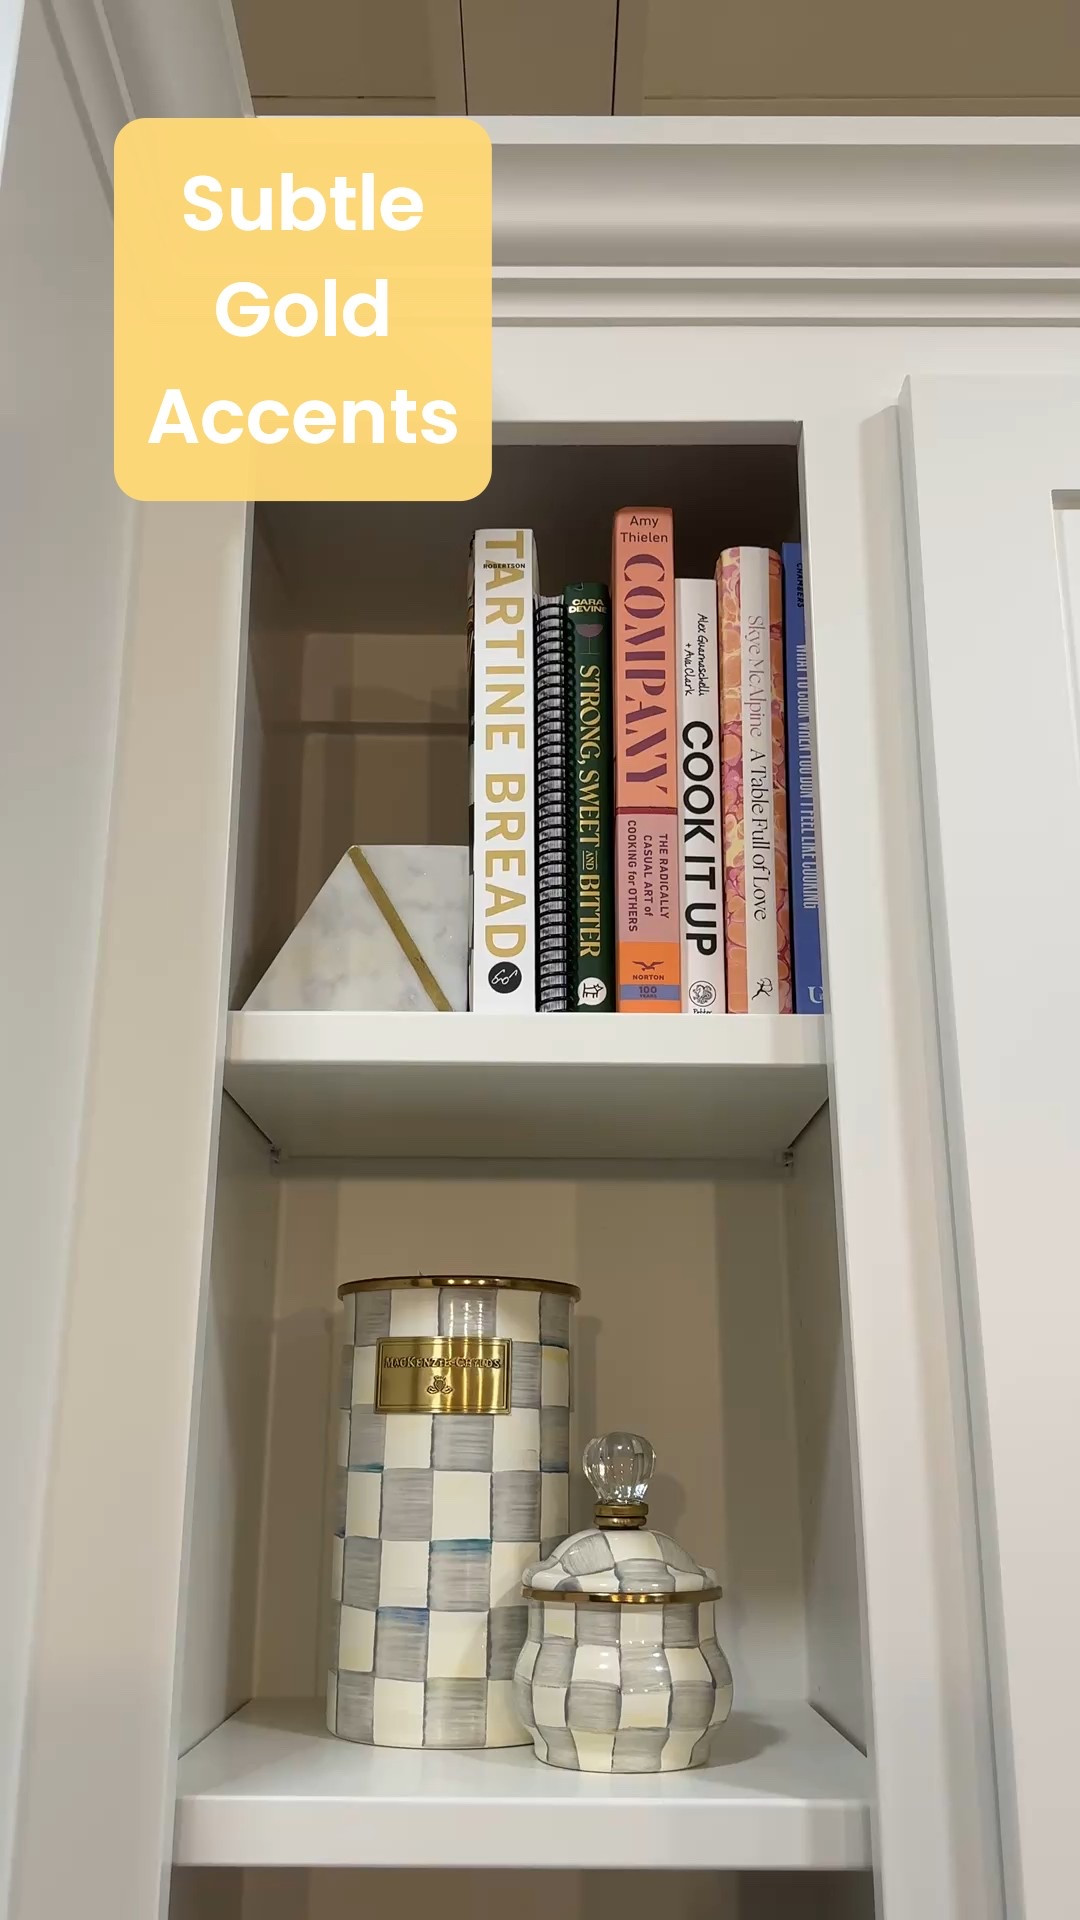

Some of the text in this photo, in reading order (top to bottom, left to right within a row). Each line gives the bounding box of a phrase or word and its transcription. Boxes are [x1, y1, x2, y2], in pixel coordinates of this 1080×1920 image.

[620, 531, 669, 544] Thielen
[629, 514, 659, 528] Amy
[568, 606, 608, 614] DEVINE
[571, 598, 605, 606] CARA
[697, 612, 709, 634] Alex
[623, 553, 668, 795] COMPANY
[684, 648, 695, 668] Ava
[684, 667, 696, 697] Clark
[744, 615, 767, 738] Skye McAlpine
[485, 530, 527, 958] TARTINE BREAD
[577, 665, 601, 957] STRONG, SWEET AND BITTER
[682, 720, 718, 956] COOK IT UP
[750, 748, 771, 922] A Table Full of Love
[627, 820, 638, 932] COOKING for OTHERS
[643, 834, 654, 917] CASUAL ART of
[659, 833, 669, 919] THE RADICALLY
[638, 986, 657, 994] 100
